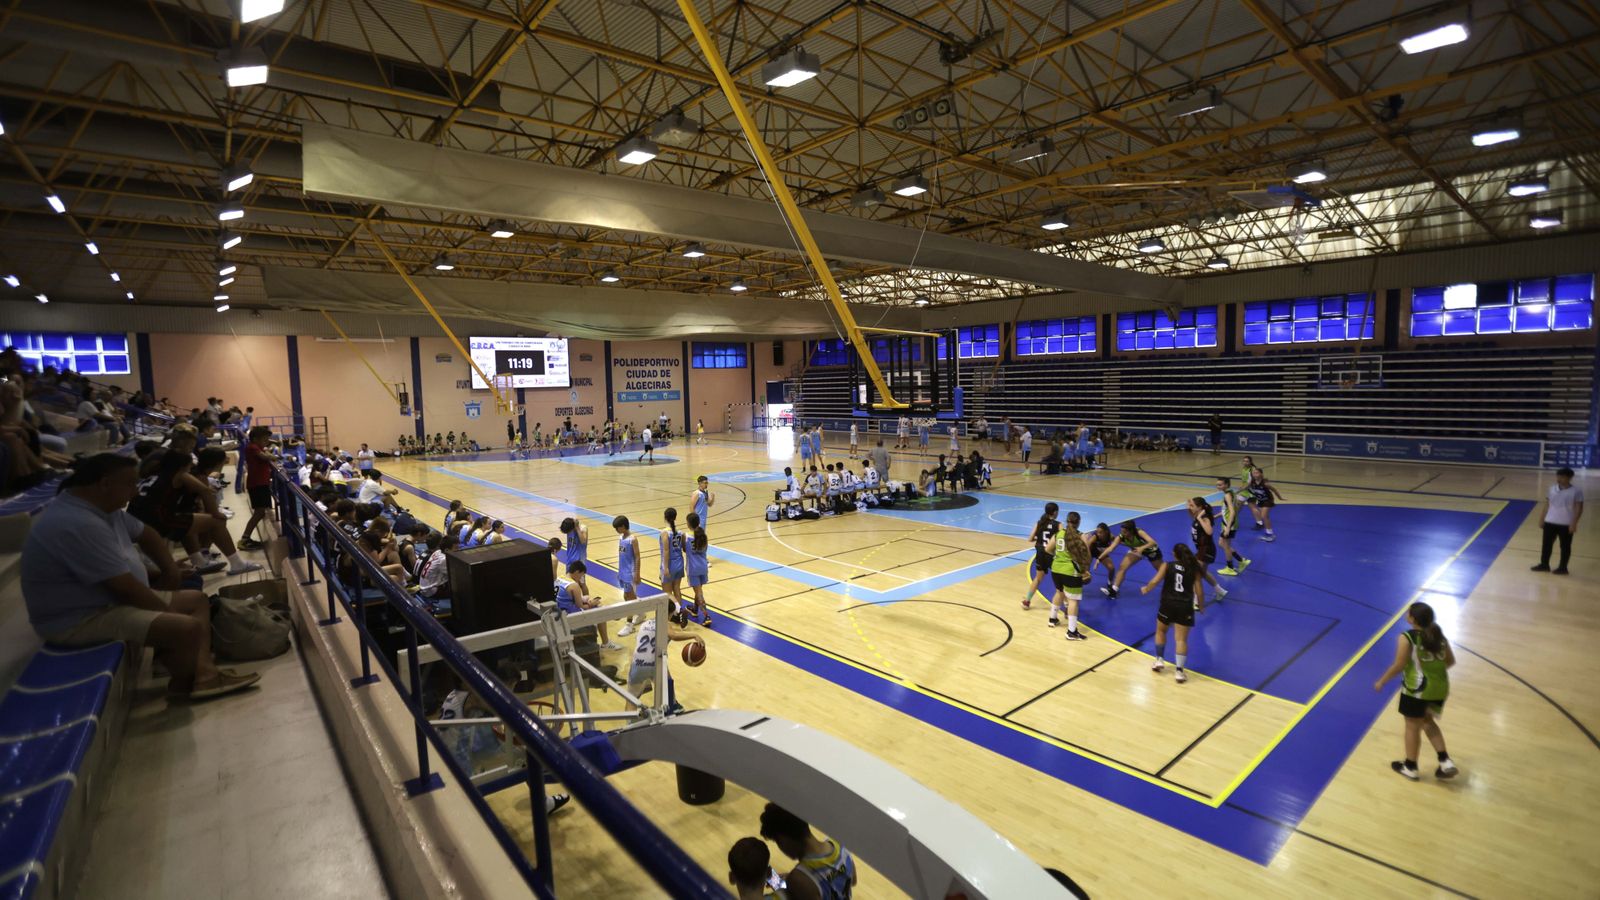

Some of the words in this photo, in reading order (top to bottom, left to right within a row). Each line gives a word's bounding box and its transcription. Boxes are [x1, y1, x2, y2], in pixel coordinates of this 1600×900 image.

[507, 357, 533, 369] 11:19
[613, 358, 680, 367] POLIDEPORTIVO
[626, 369, 658, 379] CIUDAD
[660, 369, 671, 378] DE
[625, 381, 672, 390] ALGECIRAS
[1042, 530, 1051, 547] 5
[1175, 572, 1185, 593] 8
